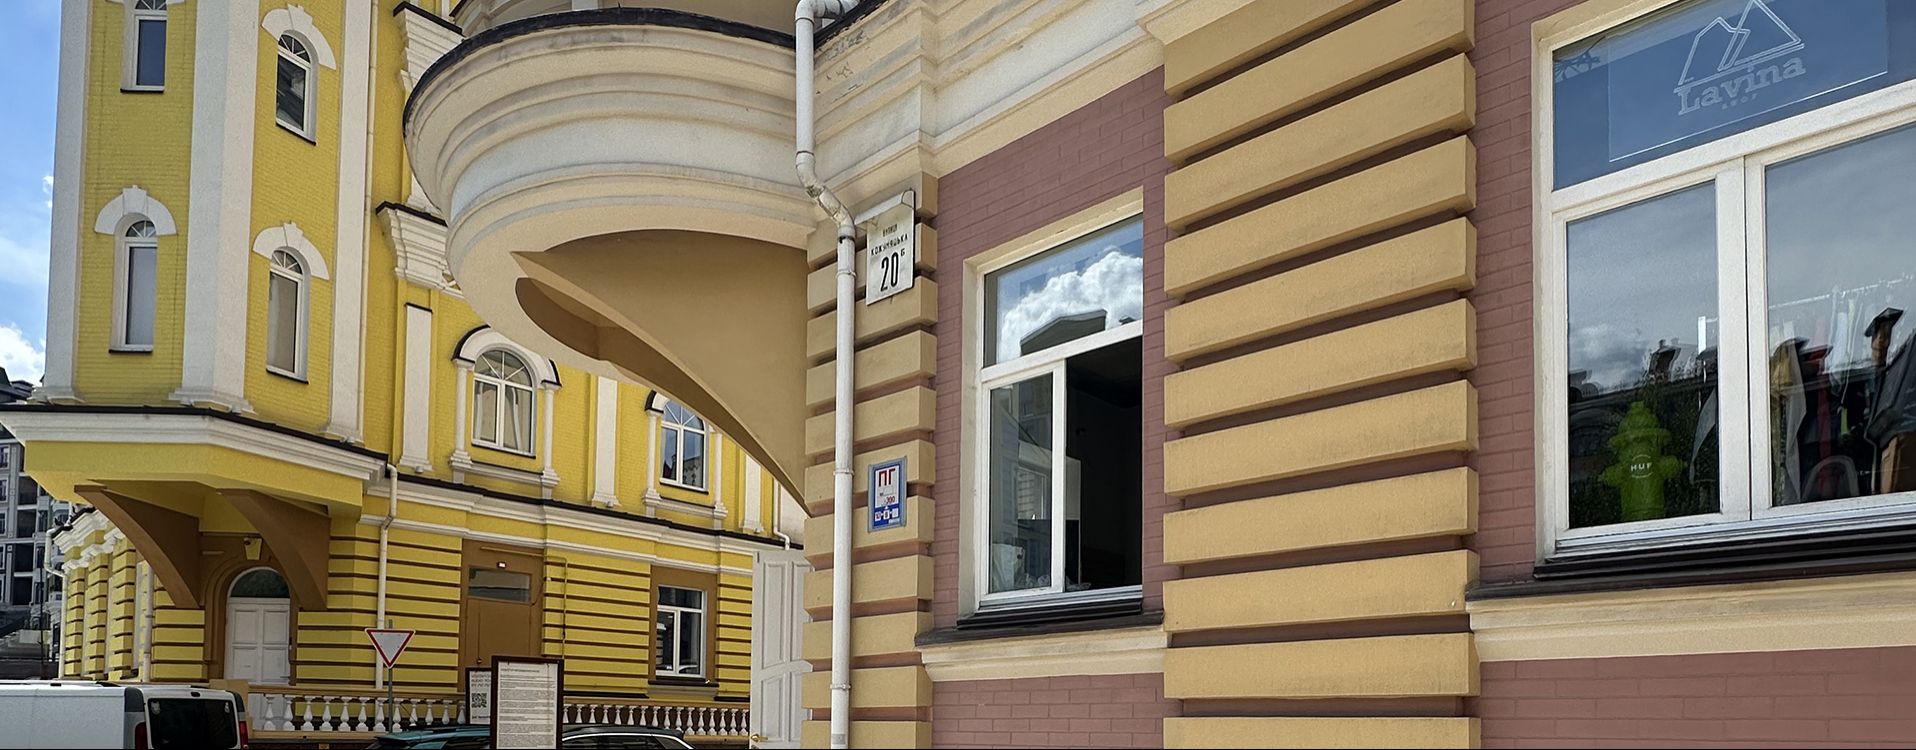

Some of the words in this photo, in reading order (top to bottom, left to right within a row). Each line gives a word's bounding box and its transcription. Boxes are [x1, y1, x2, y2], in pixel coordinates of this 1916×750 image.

[1678, 57, 1807, 115] Lavina
[880, 252, 899, 292] 20
[878, 468, 896, 487] ПГ
[1630, 462, 1652, 472] HUF
